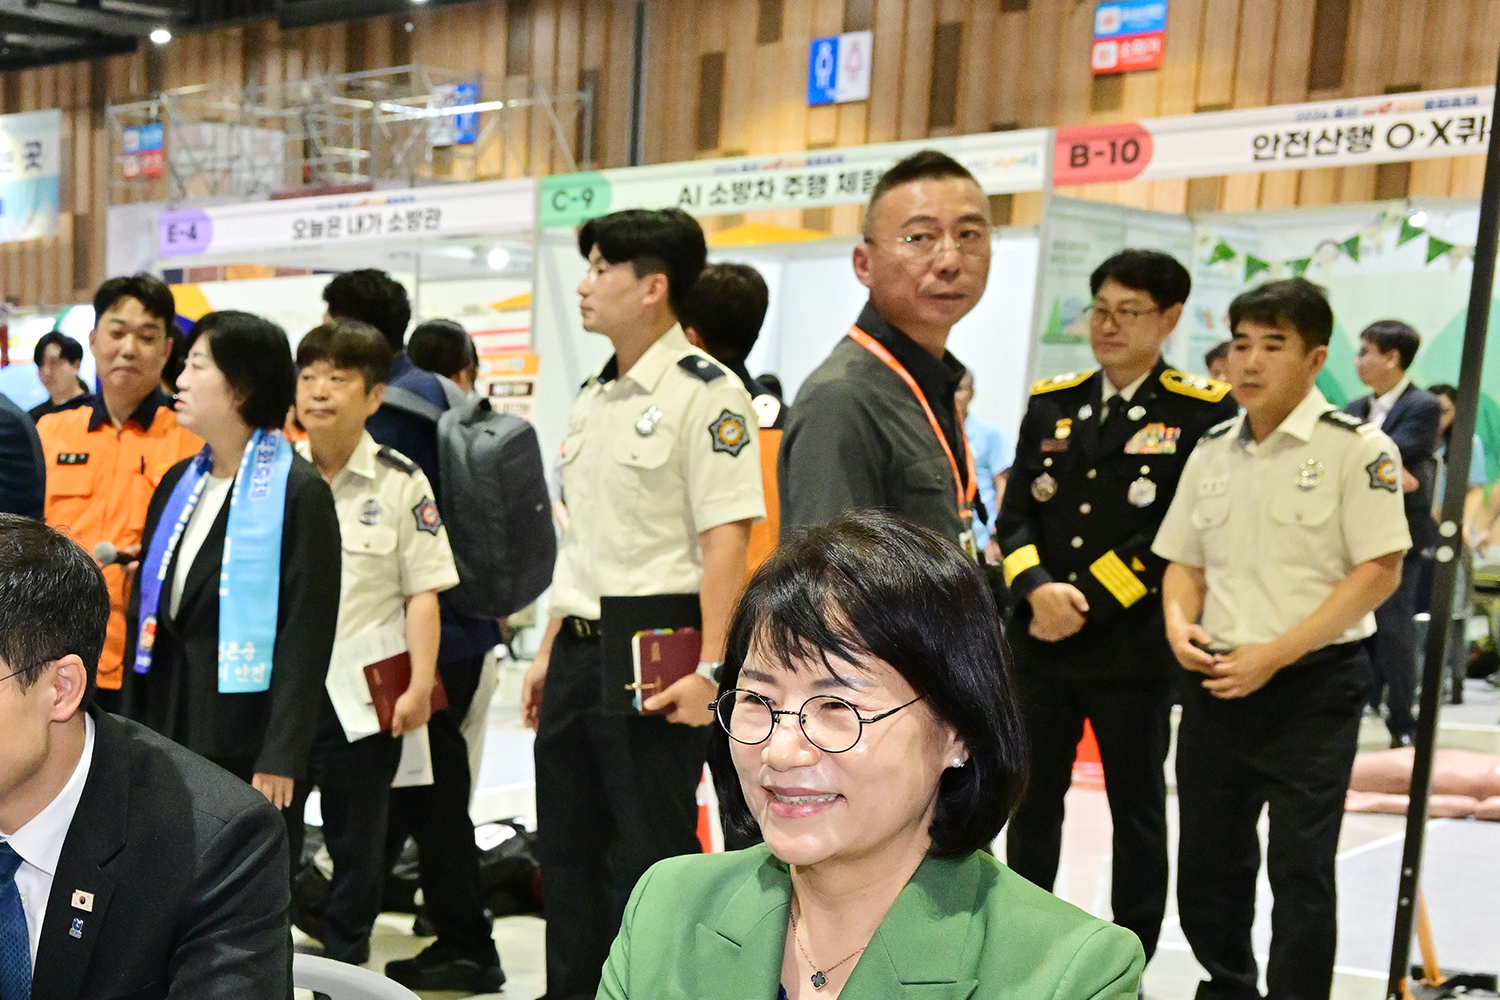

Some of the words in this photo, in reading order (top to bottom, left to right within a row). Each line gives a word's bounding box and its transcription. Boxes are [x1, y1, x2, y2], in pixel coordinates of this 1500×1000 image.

[1252, 121, 1375, 161] 안전산행
[1386, 115, 1487, 149] O·X퀴
[1070, 140, 1140, 167] B-10
[552, 186, 597, 212] C-9
[678, 187, 702, 207] AI
[709, 177, 775, 206] 소방차
[784, 174, 829, 199] 주행
[167, 222, 198, 243] E-4
[292, 215, 341, 239] 오늘은
[347, 212, 383, 235] 내가
[388, 207, 442, 232] 소방관
